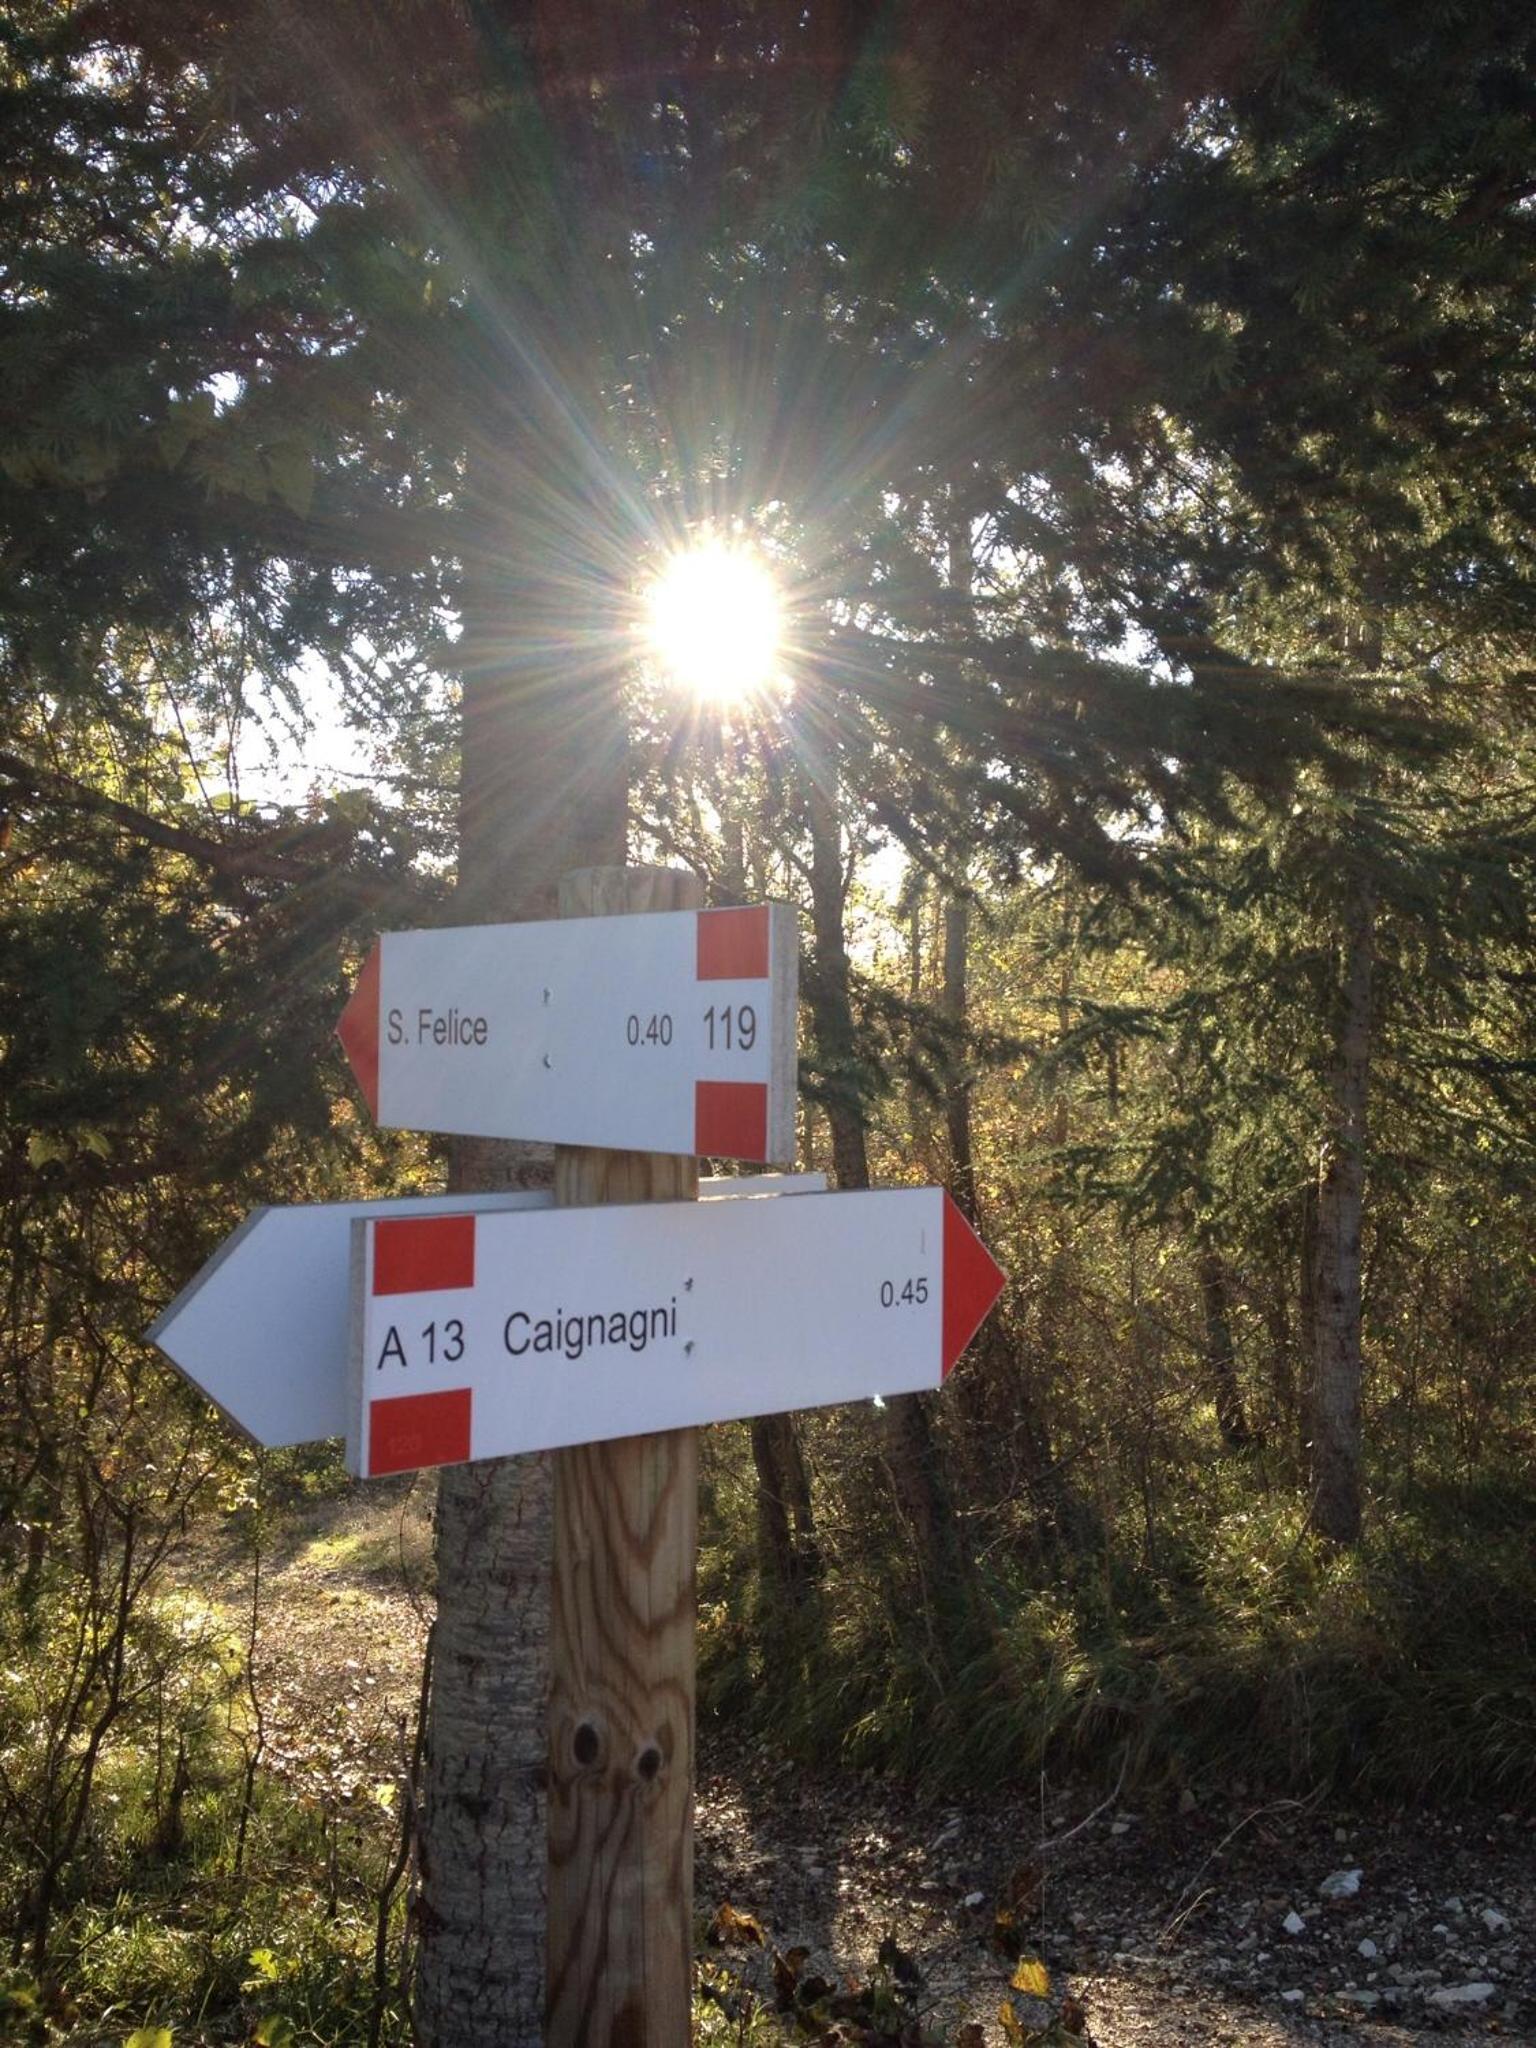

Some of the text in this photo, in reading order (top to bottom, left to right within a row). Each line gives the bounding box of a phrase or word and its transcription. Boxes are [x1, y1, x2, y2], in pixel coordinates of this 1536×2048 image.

[387, 1004, 757, 1052] S. Felice 0.40 119
[377, 1277, 929, 1371] A 13 Caignagni 0.45
